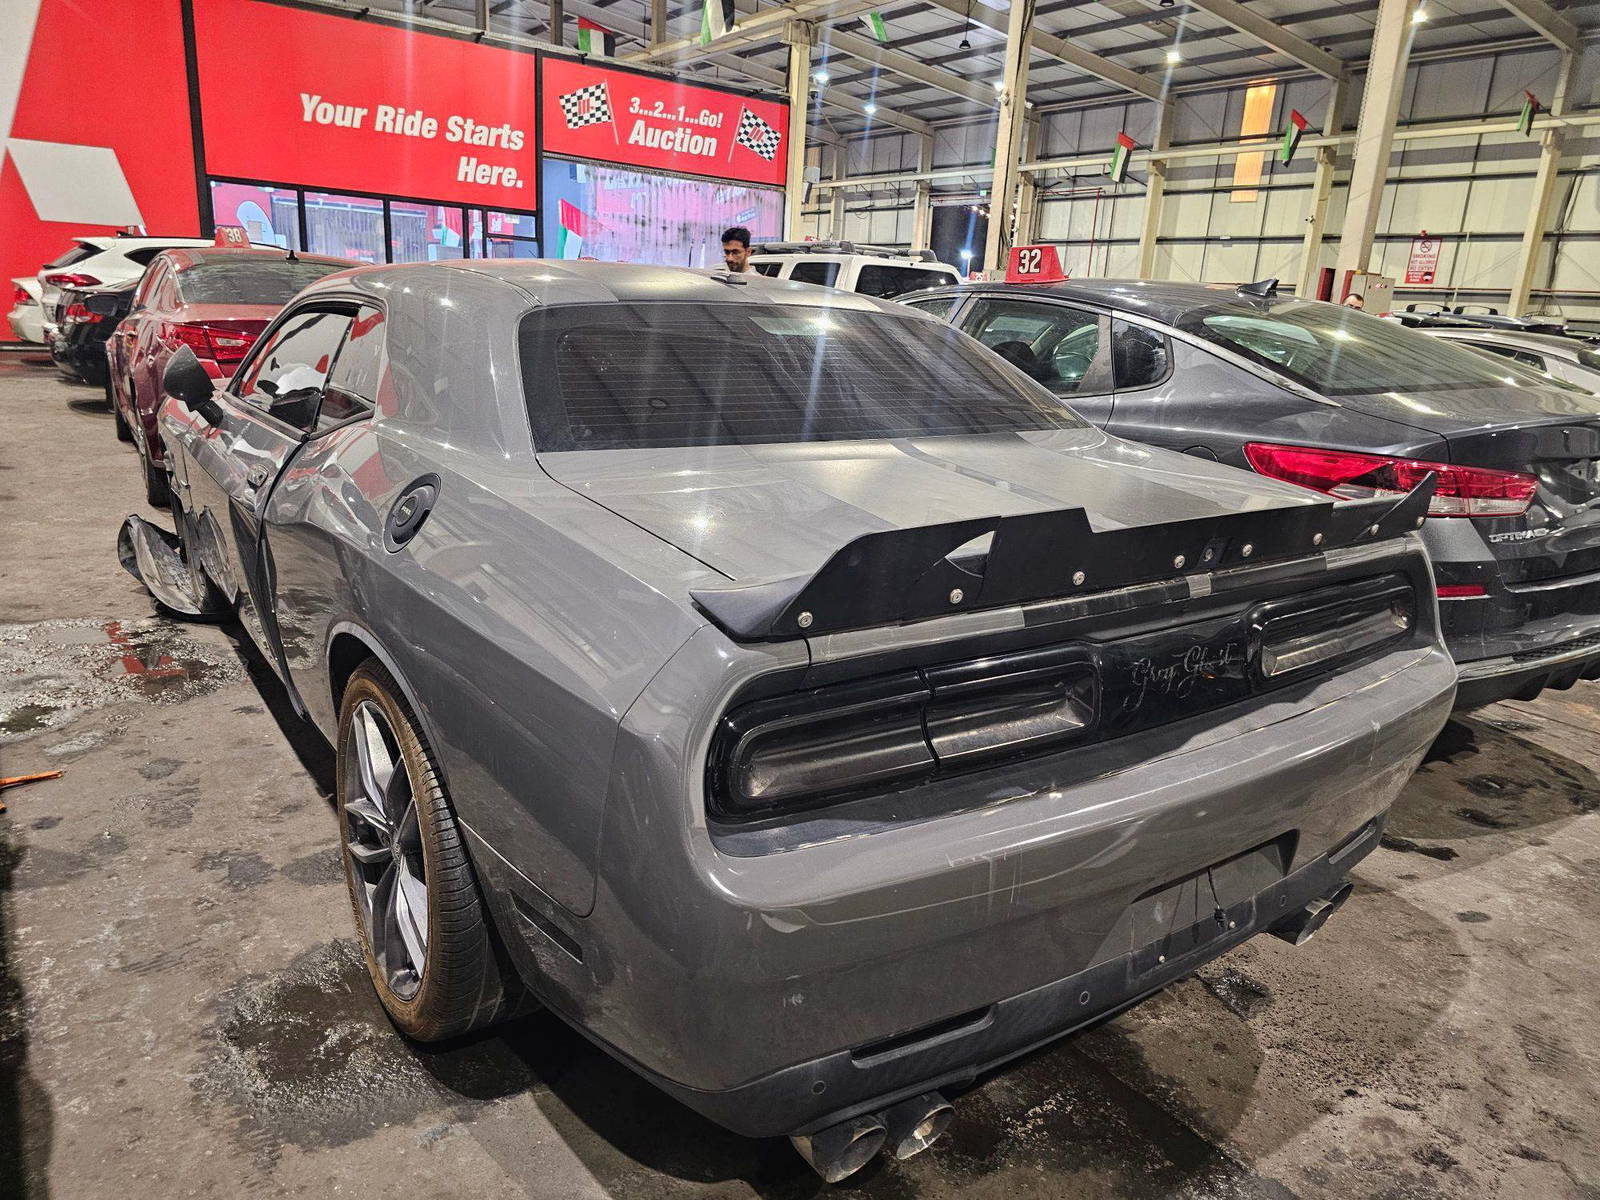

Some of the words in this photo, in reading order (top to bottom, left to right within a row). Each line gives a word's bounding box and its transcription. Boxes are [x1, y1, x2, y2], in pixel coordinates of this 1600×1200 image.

[300, 92, 368, 129] Your
[374, 104, 438, 139] Ride
[445, 115, 525, 151] Starts
[629, 97, 724, 129] 3...2...1...Go!
[628, 120, 718, 157] Auction
[457, 156, 524, 188] Here.
[227, 228, 242, 243] 38
[1018, 248, 1042, 274] 32
